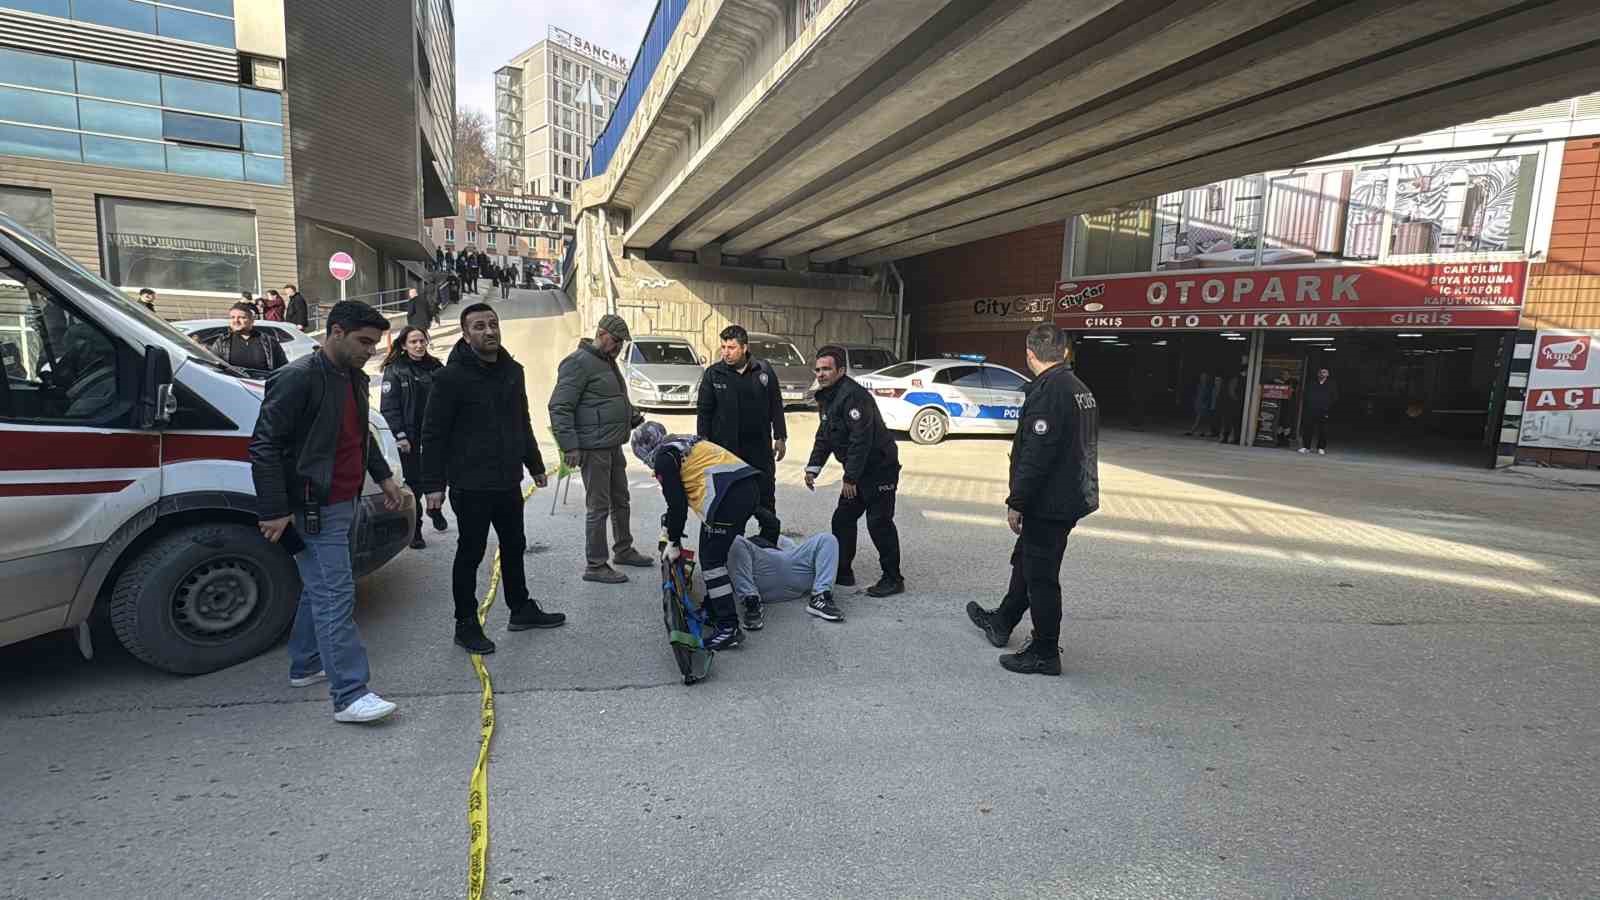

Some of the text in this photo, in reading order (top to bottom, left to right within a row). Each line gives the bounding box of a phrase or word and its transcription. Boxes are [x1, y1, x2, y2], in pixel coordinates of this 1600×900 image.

[574, 36, 627, 70] SANCAK
[1443, 262, 1503, 274] CAM FİLMİ
[1431, 274, 1513, 285] BOYA KORUMA
[1146, 274, 1361, 305] OTOPARK
[1454, 284, 1502, 295] KUAFÖR
[1424, 295, 1515, 305] KAPUT KORUMA
[1085, 316, 1123, 328] ÇIKIŞ
[1150, 313, 1343, 328] OTO YIKAMA
[1391, 311, 1454, 326] GİRİŞ
[1003, 408, 1020, 419] POL
